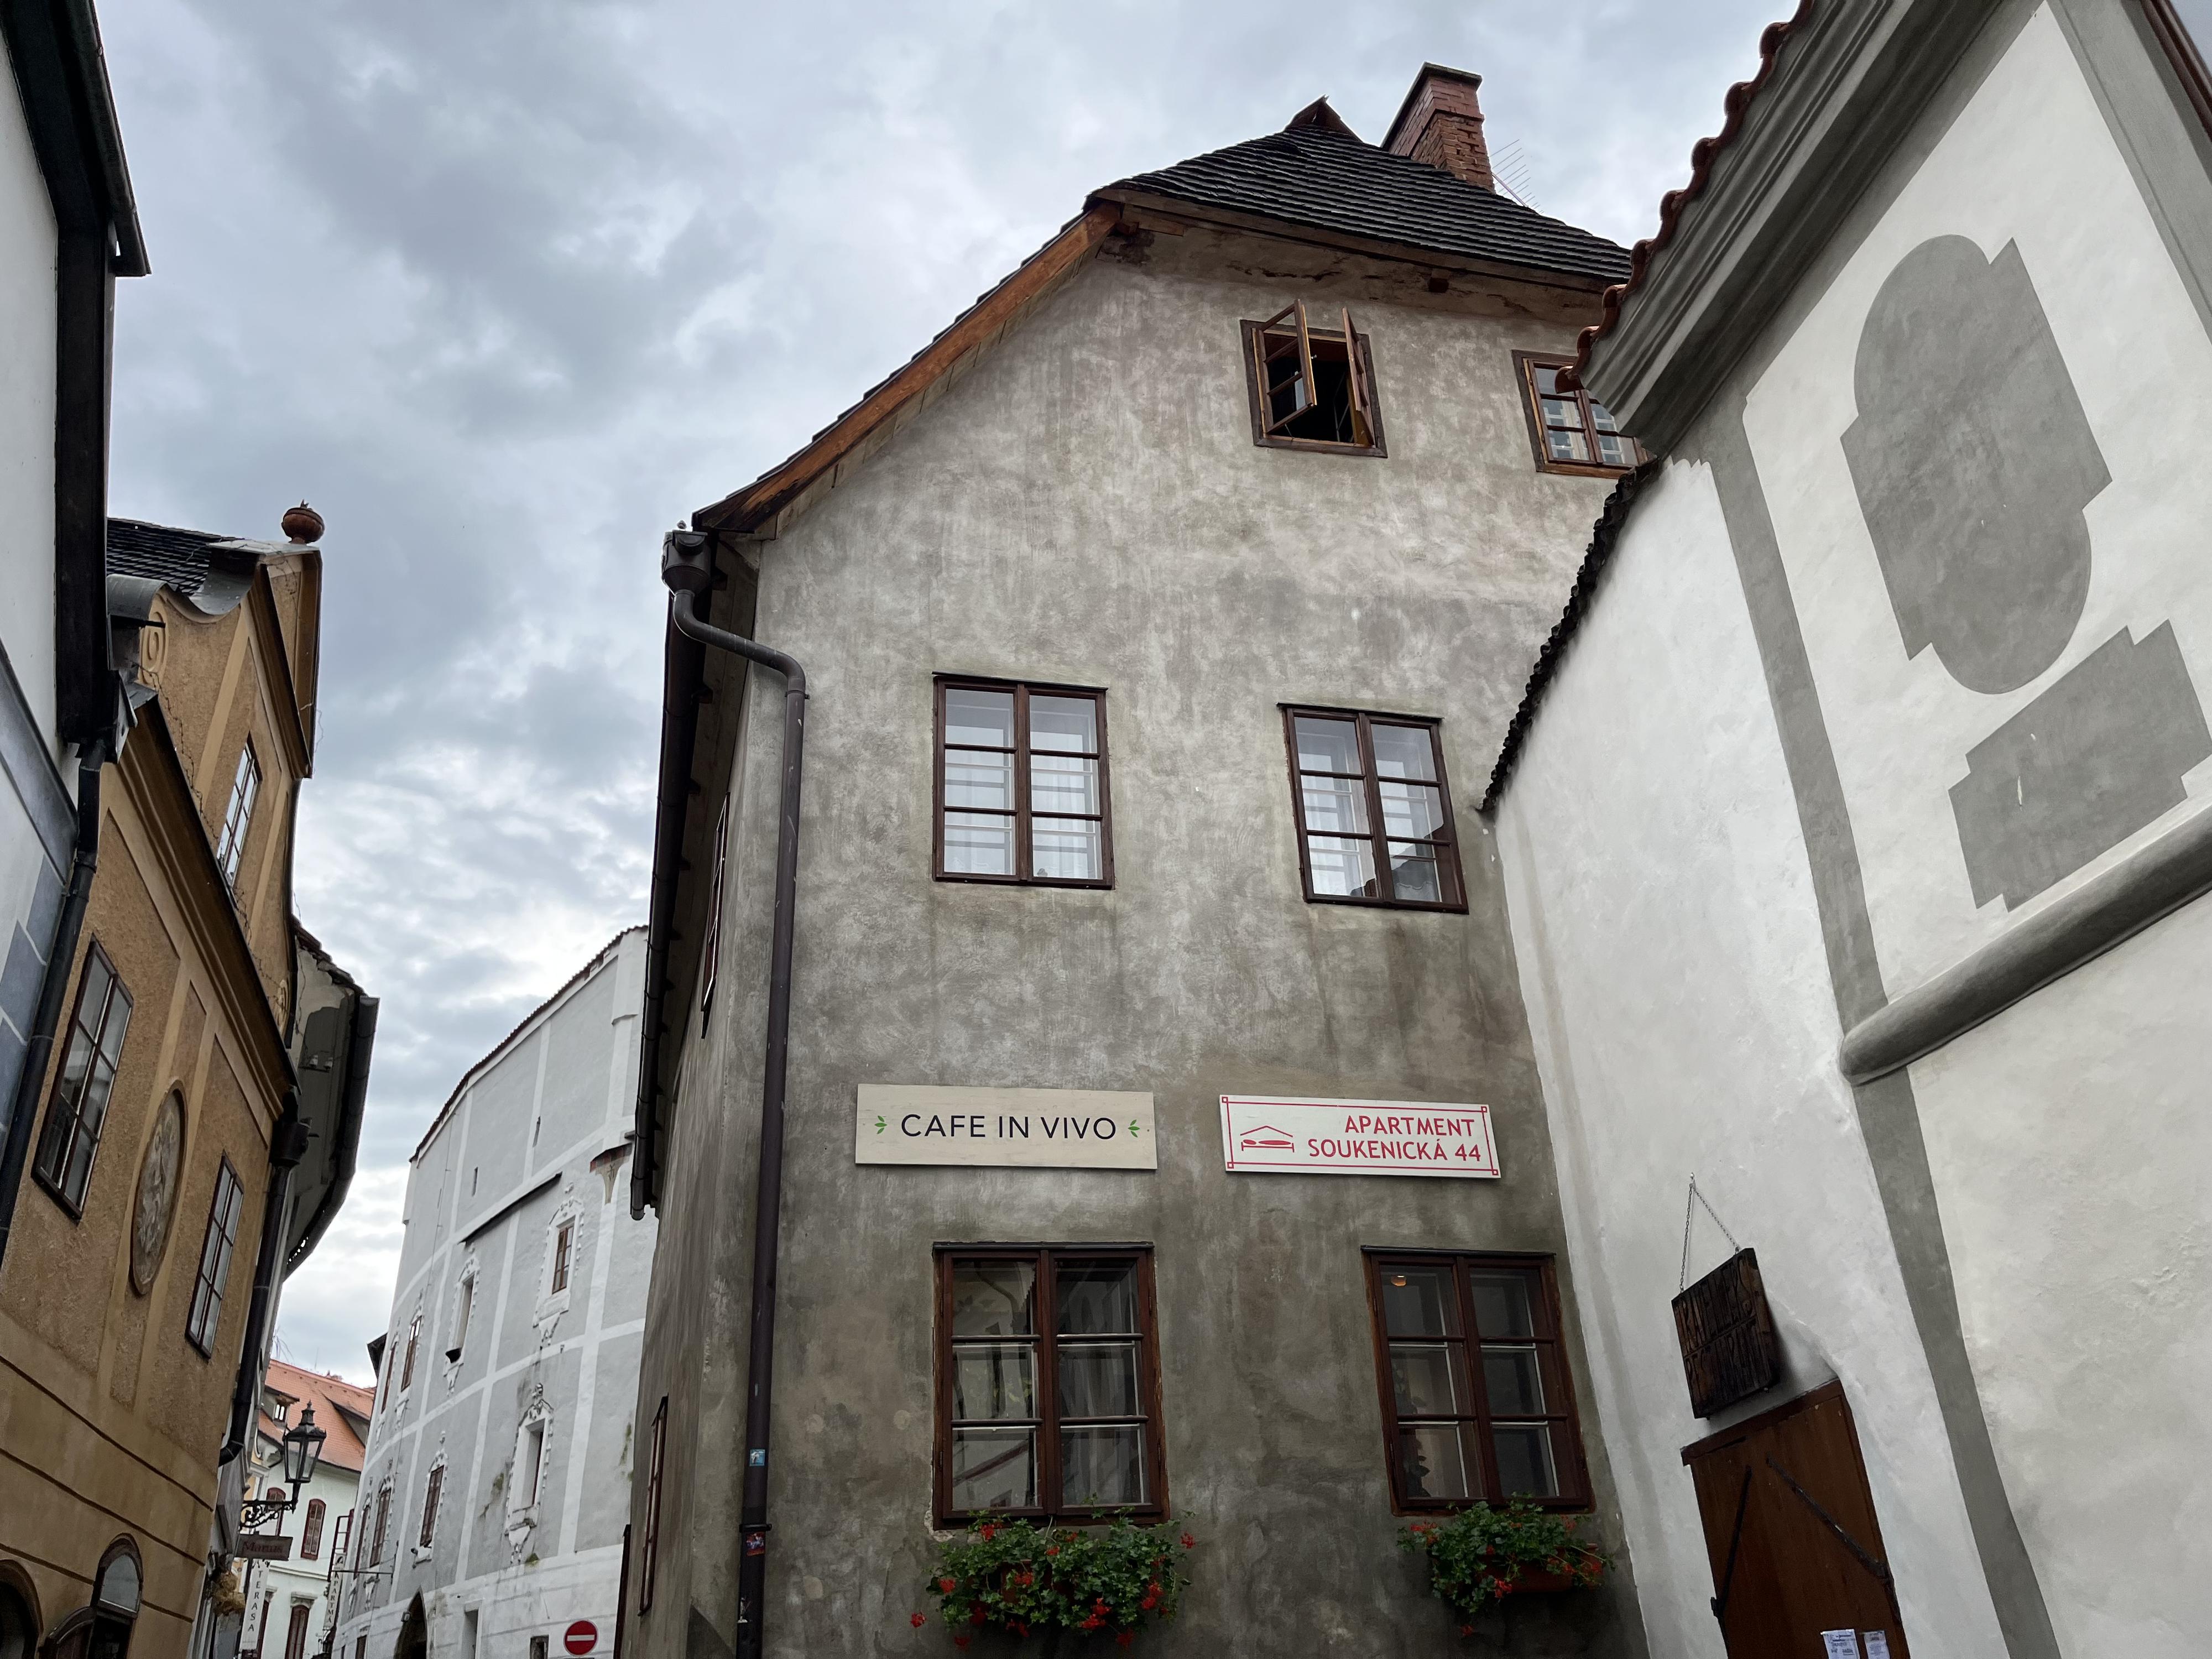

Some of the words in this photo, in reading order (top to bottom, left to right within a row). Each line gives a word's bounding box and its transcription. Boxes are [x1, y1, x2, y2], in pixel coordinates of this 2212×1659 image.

[901, 1114, 985, 1138] CAFE
[999, 1116, 1029, 1138] IN
[1040, 1117, 1116, 1140] VIVO
[1345, 1115, 1474, 1136] APARTMENT
[1308, 1139, 1448, 1160] SOUKENICKÁ
[1455, 1144, 1481, 1162] 44
[248, 1570, 263, 1632] TERASA
